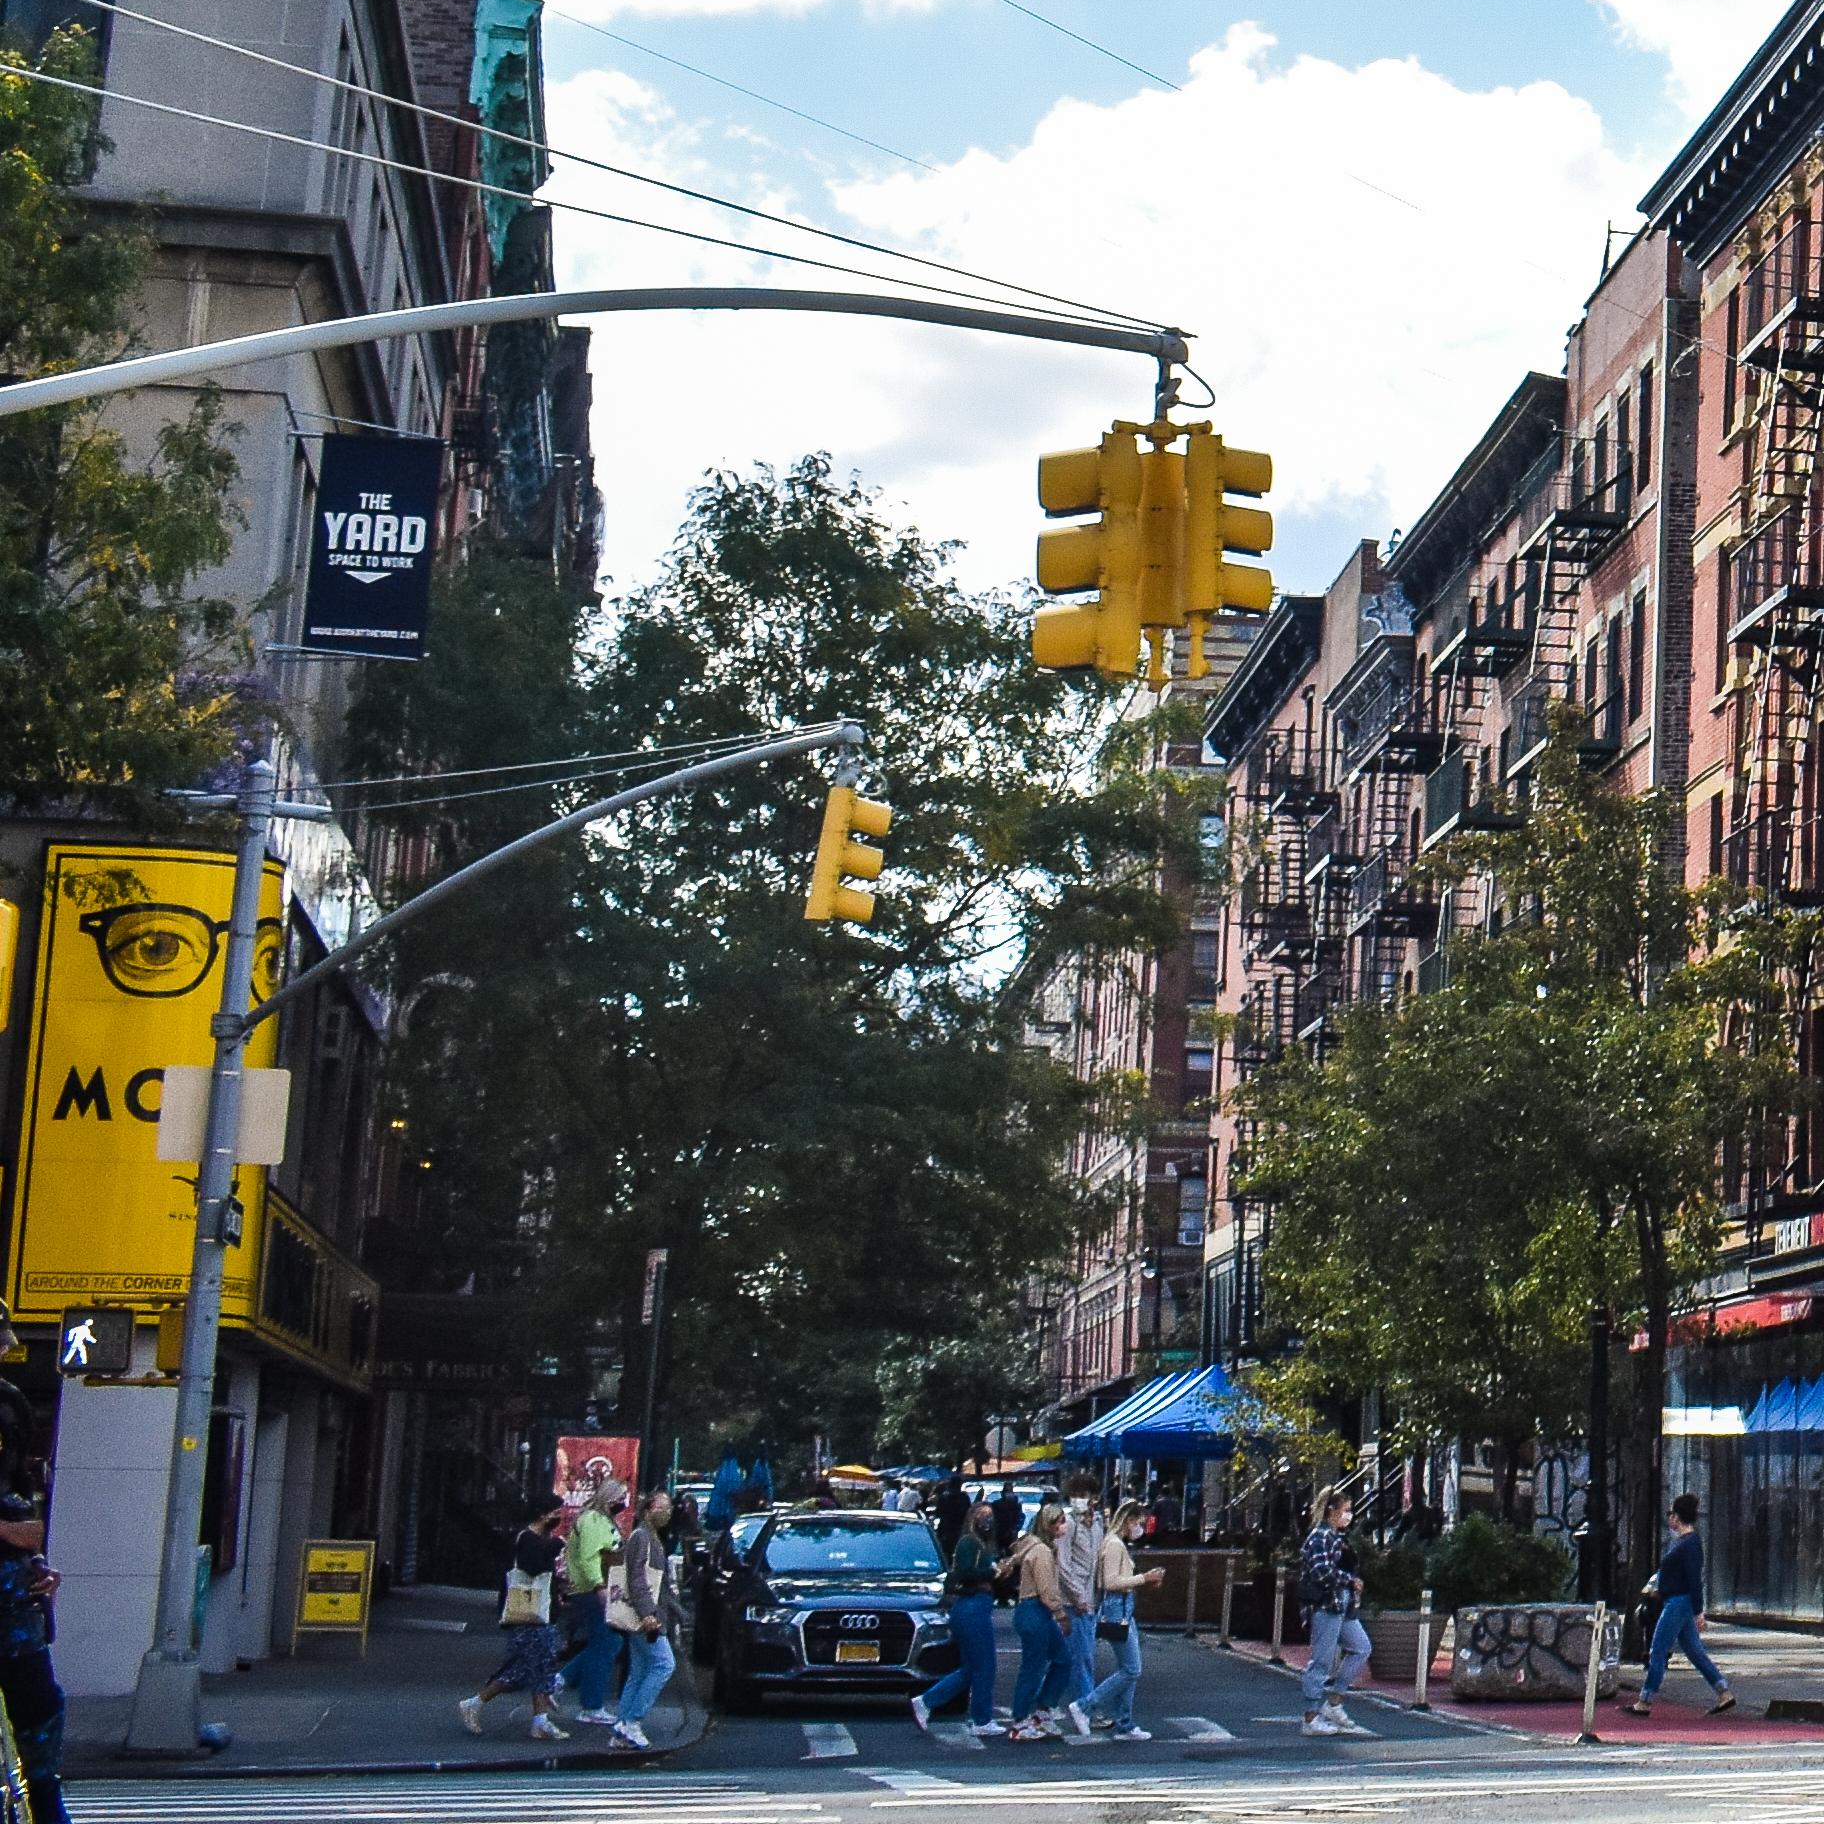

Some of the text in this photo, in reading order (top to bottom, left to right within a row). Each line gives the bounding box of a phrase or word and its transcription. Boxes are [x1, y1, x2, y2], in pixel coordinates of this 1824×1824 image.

[359, 493, 393, 511] THE
[324, 511, 427, 554] YARD
[328, 553, 414, 569] SPACE TO WORK
[29, 1277, 183, 1291] AROUND THE CORNER
